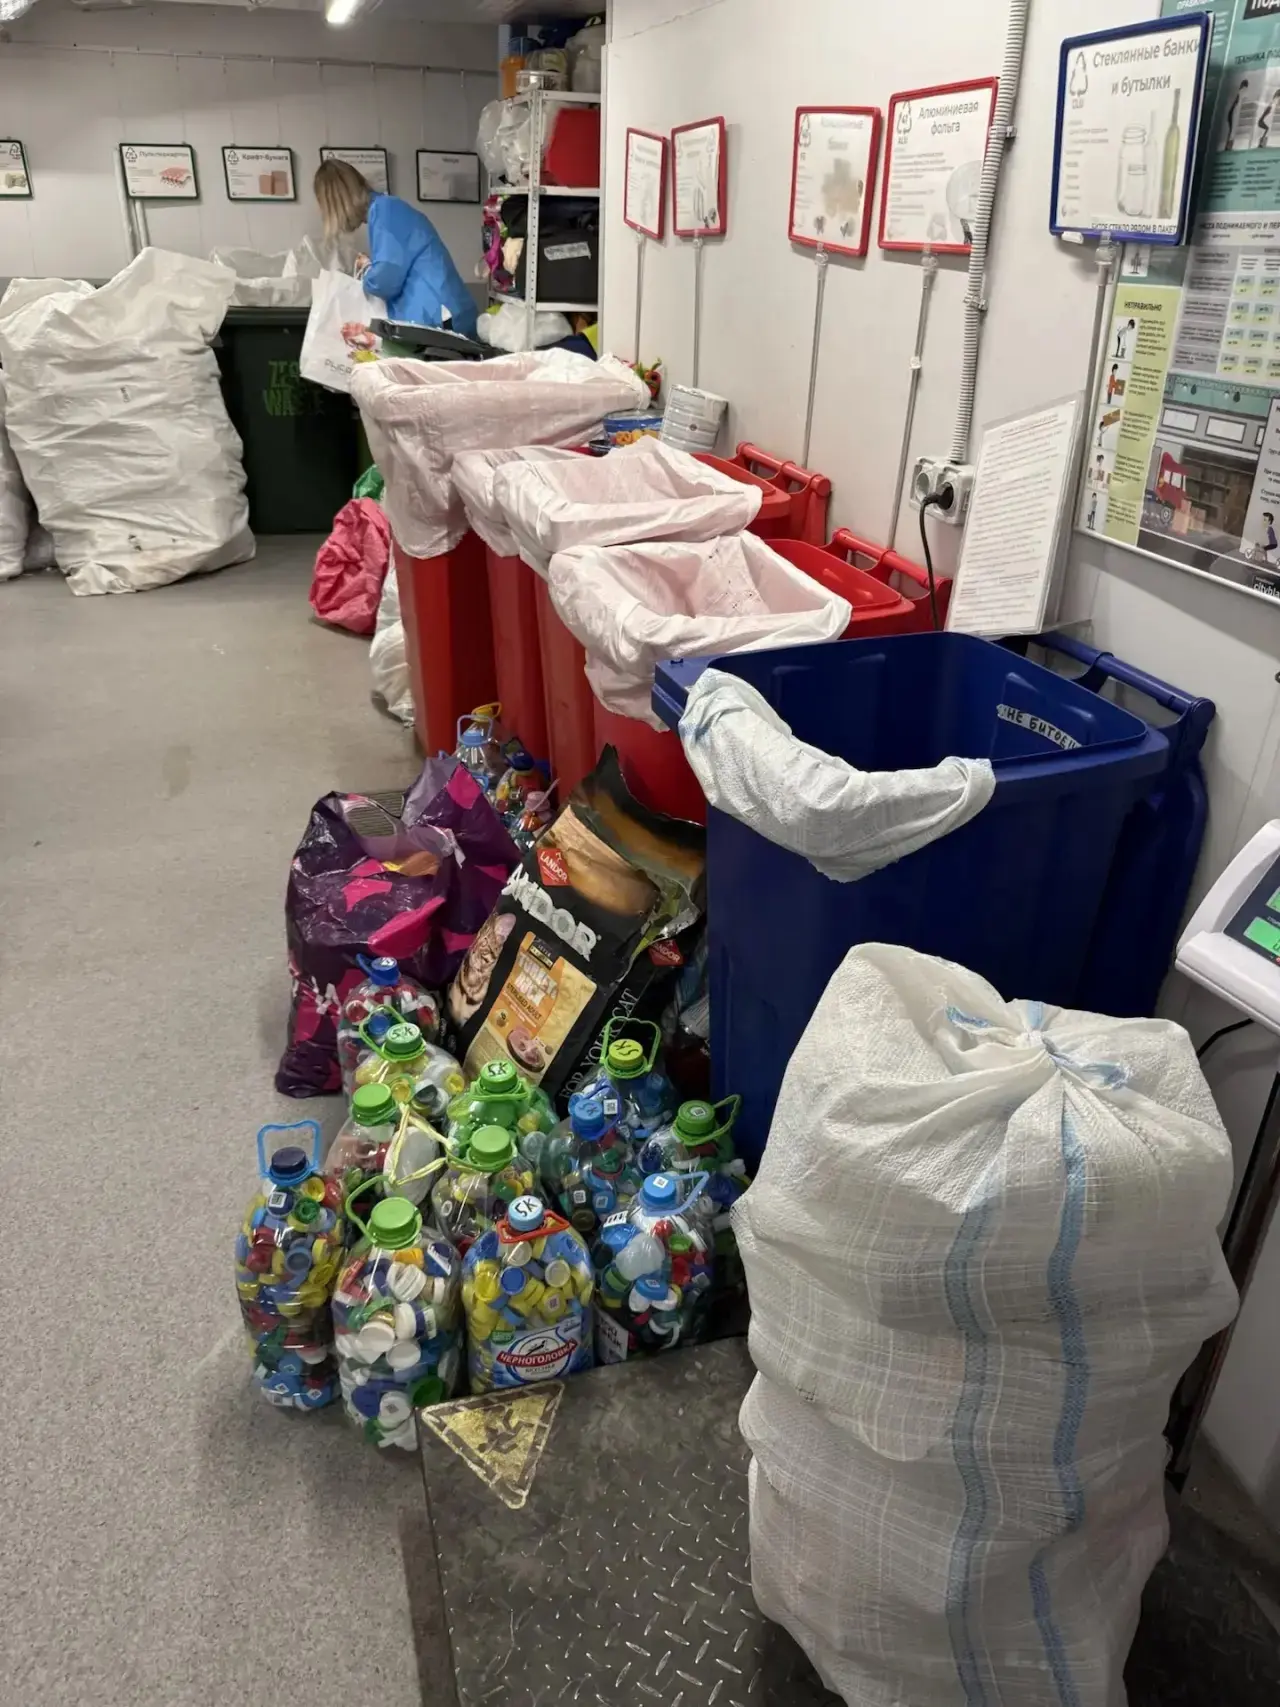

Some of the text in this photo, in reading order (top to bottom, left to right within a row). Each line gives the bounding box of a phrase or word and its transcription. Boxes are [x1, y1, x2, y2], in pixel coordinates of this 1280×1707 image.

[1093, 45, 1160, 68] Стеклянные
[1111, 75, 1171, 97] и бутылки
[918, 101, 979, 120] Алюминиевая
[930, 121, 961, 136] фольга
[1007, 707, 1023, 724] НЕ
[540, 850, 568, 884] LANDOR
[611, 988, 640, 1025] CAT
[500, 1341, 576, 1366] ЧЕРНОГОЛОВКА
